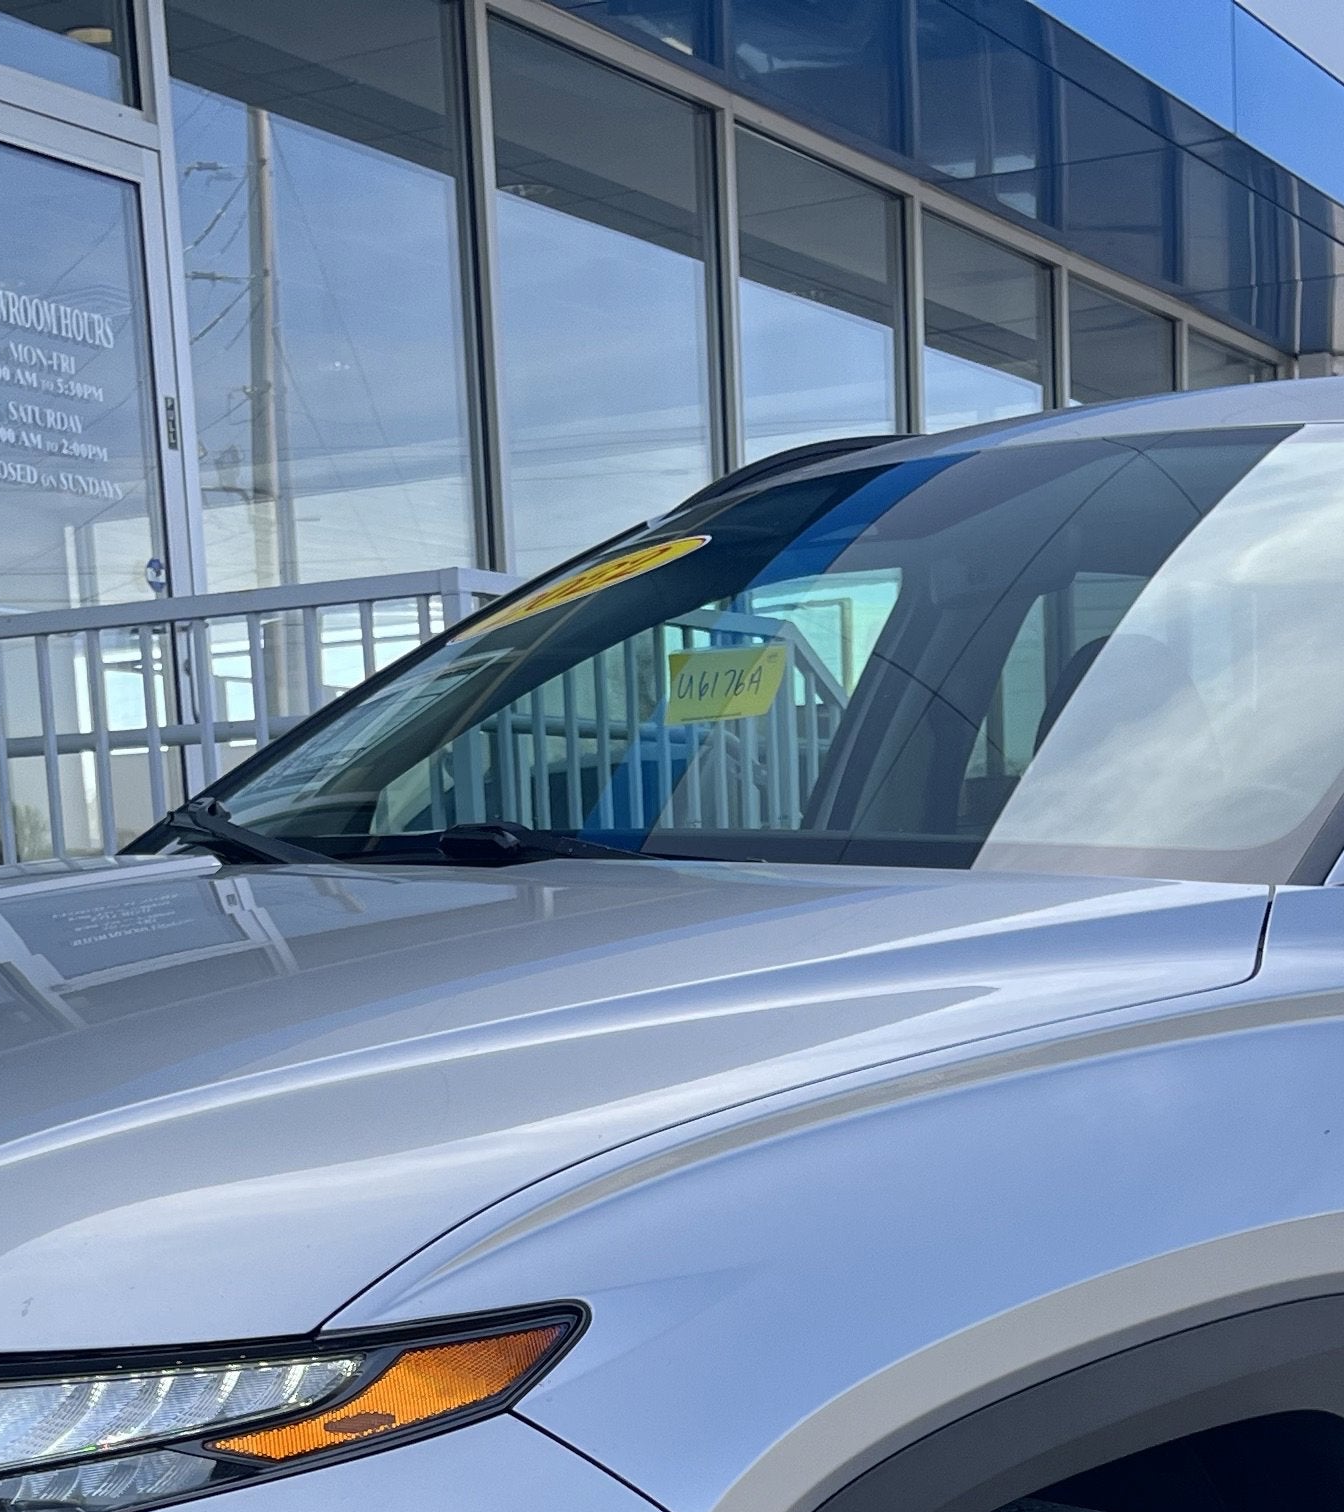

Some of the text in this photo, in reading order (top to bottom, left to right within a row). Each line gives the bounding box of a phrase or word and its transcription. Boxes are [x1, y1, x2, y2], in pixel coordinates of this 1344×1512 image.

[59, 305, 114, 349] HOURS
[9, 340, 75, 375] MON-FRI
[14, 368, 38, 388] AM
[8, 401, 83, 434] SATURDAY
[19, 431, 42, 449] AM
[59, 472, 124, 500] SUNDAYS
[677, 664, 763, 701] U6176A
